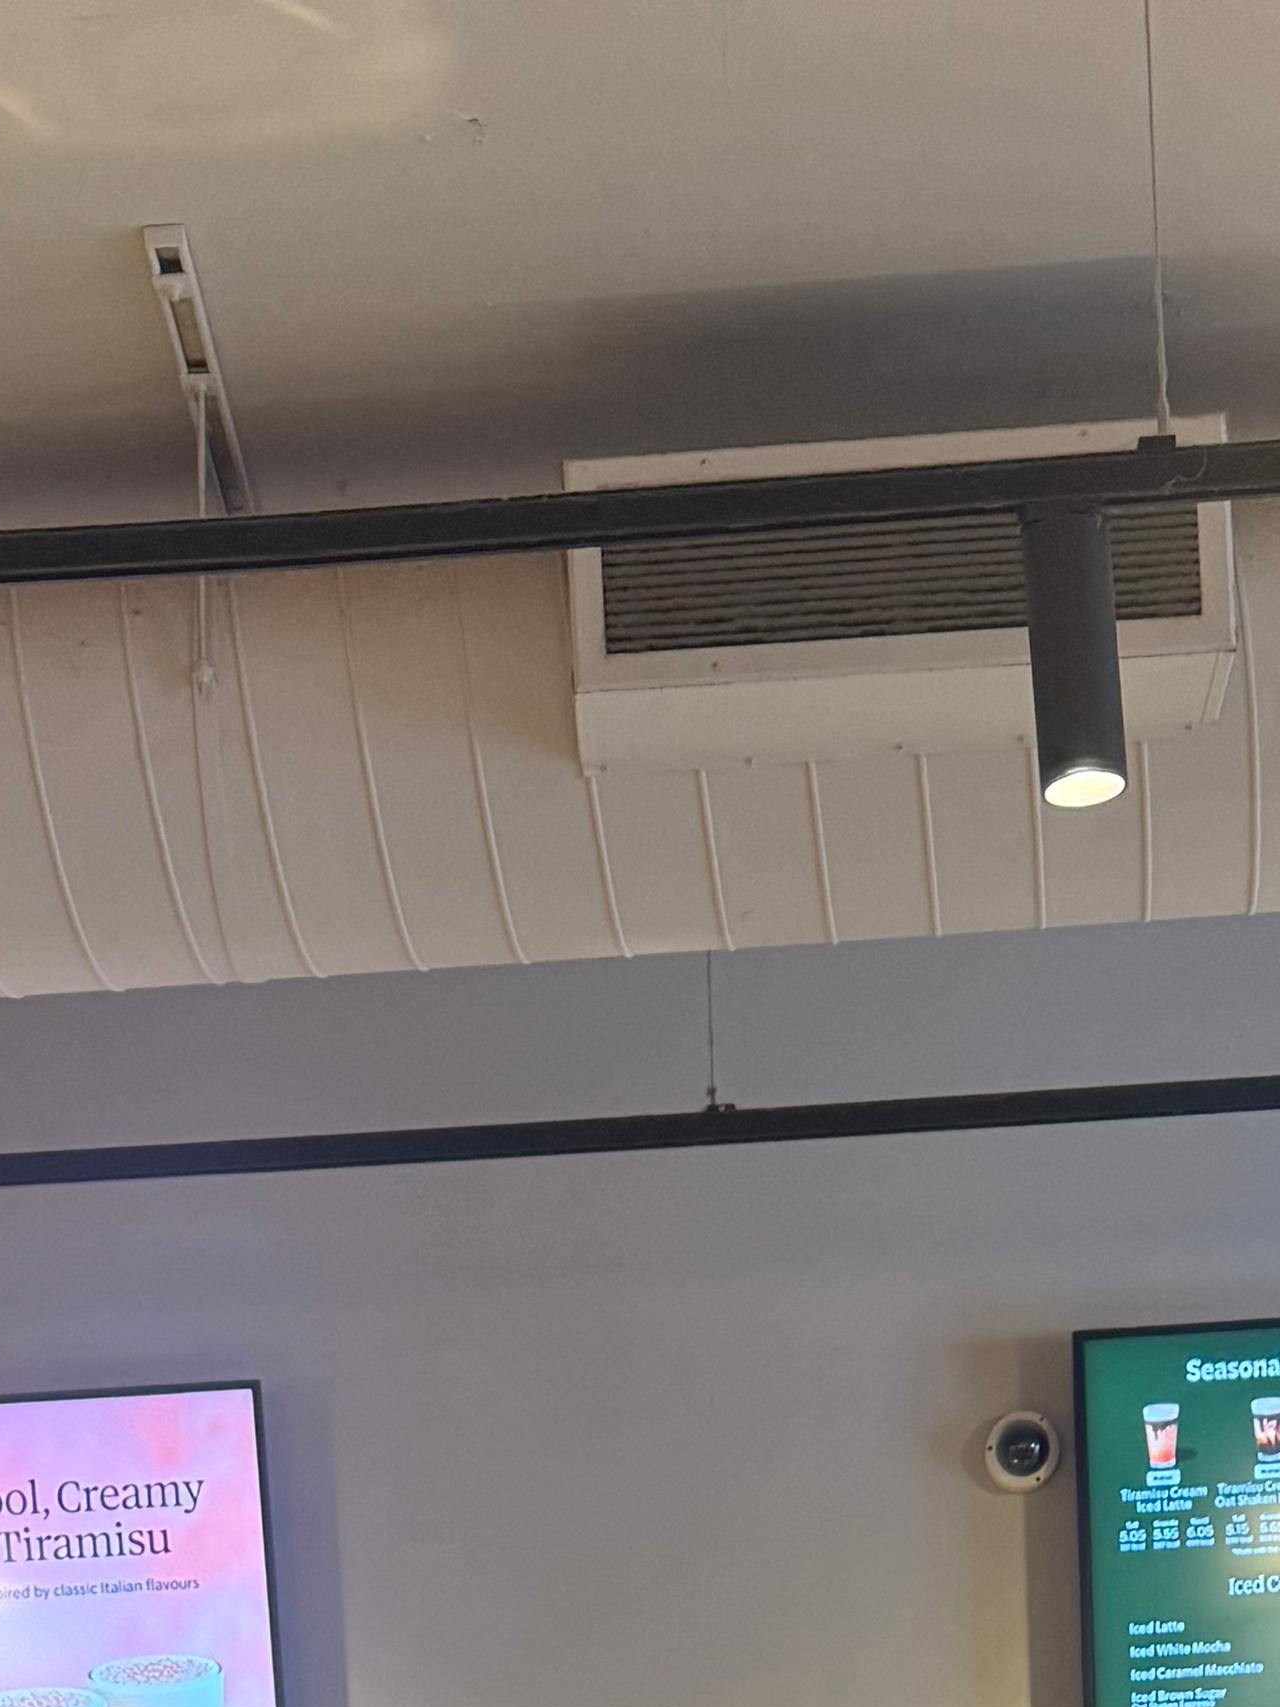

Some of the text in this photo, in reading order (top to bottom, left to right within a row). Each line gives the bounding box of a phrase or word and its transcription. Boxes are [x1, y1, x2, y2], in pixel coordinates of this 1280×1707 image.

[57, 1479, 205, 1514] Creamy
[1120, 1486, 1208, 1502] Tiramisu Cream
[1136, 1499, 1193, 1513] Iced Latte
[34, 1584, 51, 1601] by
[53, 1581, 99, 1597] classic
[100, 1579, 143, 1595] Italian
[145, 1576, 200, 1592] flavours
[1228, 1575, 1265, 1596] Iced
[1129, 1620, 1185, 1635] Iced Latte
[1130, 1640, 1231, 1658] Iced White Mocha
[1130, 1662, 1264, 1682] Iced Caramel Macchiato
